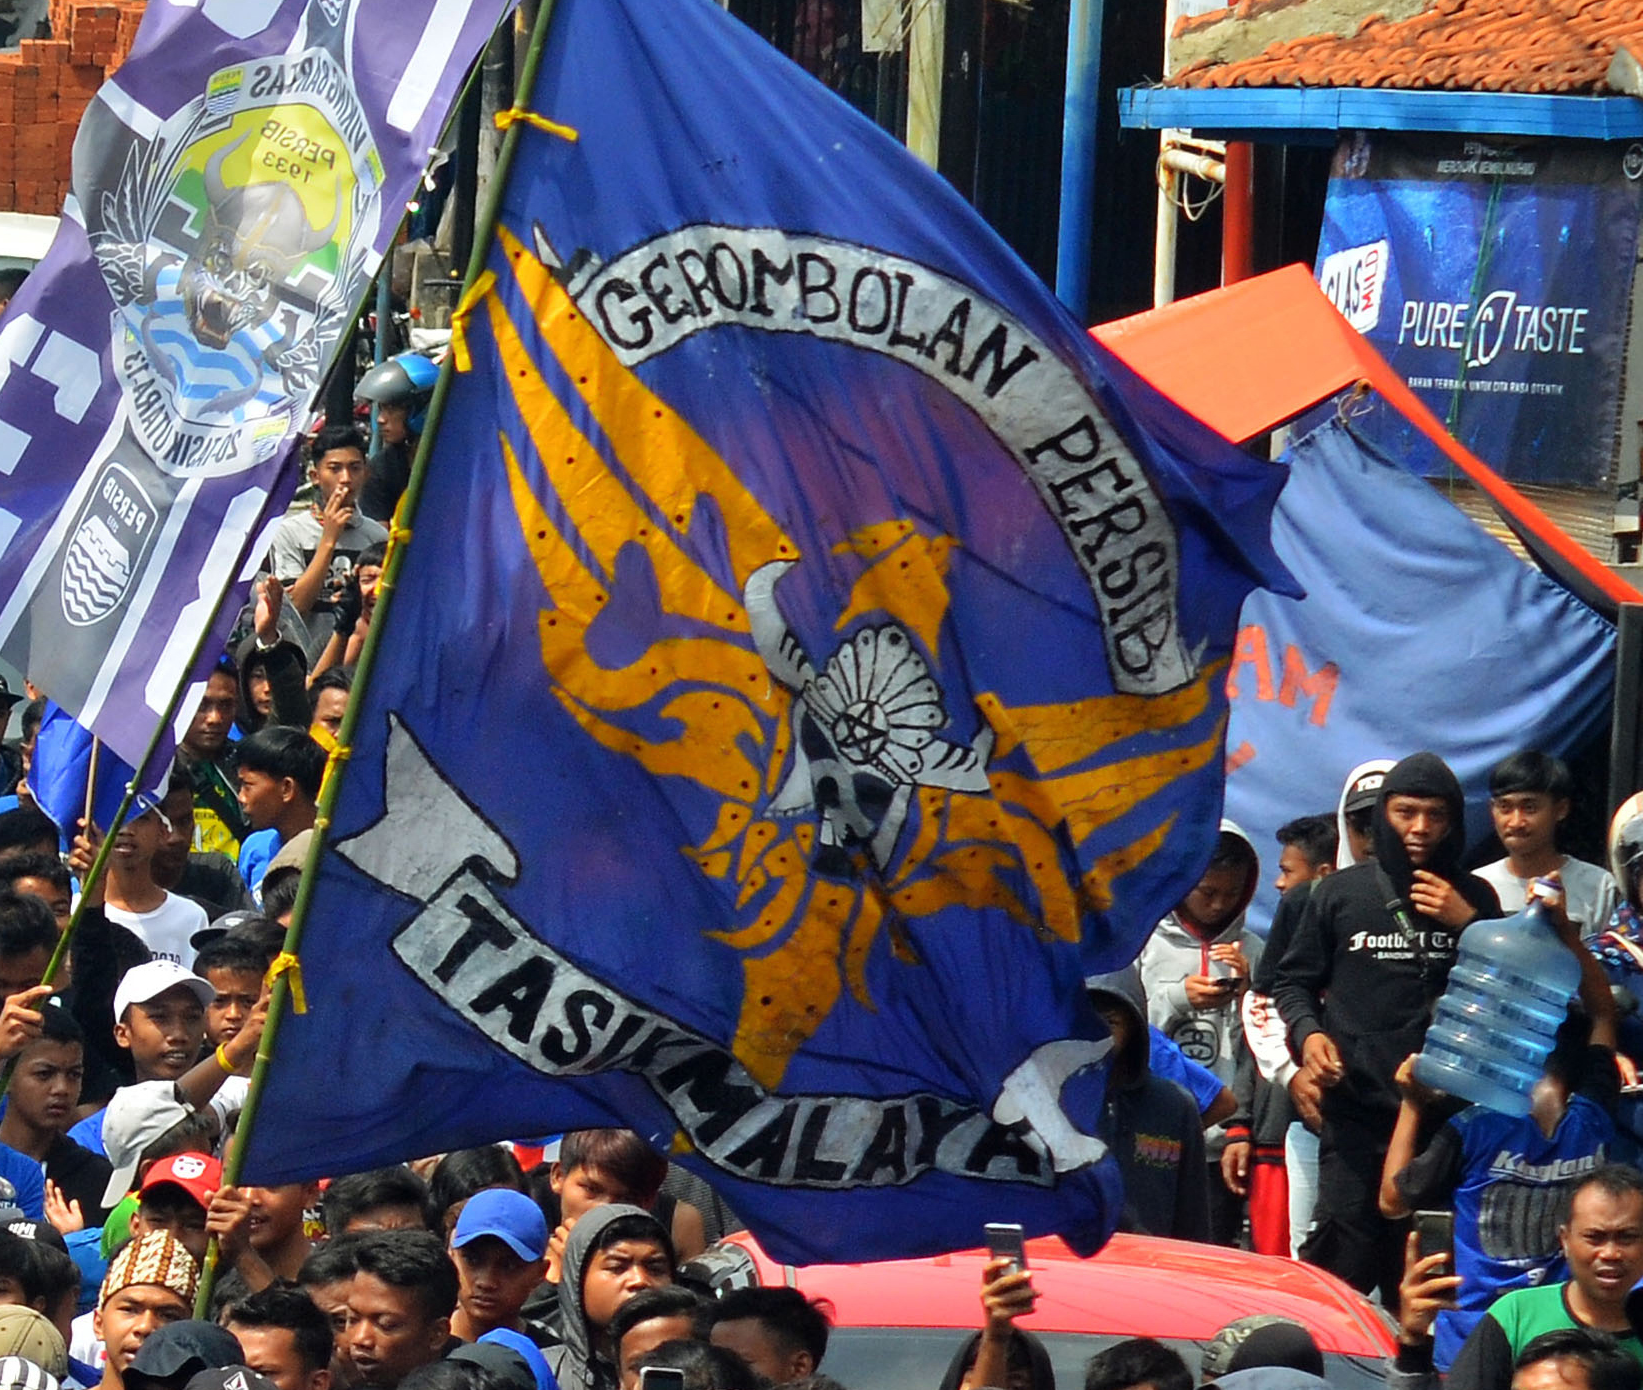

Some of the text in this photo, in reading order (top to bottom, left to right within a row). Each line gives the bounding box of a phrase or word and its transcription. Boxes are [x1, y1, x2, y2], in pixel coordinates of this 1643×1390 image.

[1361, 249, 1380, 313] MILD
[1399, 300, 1589, 354] PURE TASTE
[1434, 377, 1467, 390] TERBAK
[595, 241, 1177, 676] GEROMBOLAN PERSIB
[431, 892, 1042, 1185] TASIKMALAYA
